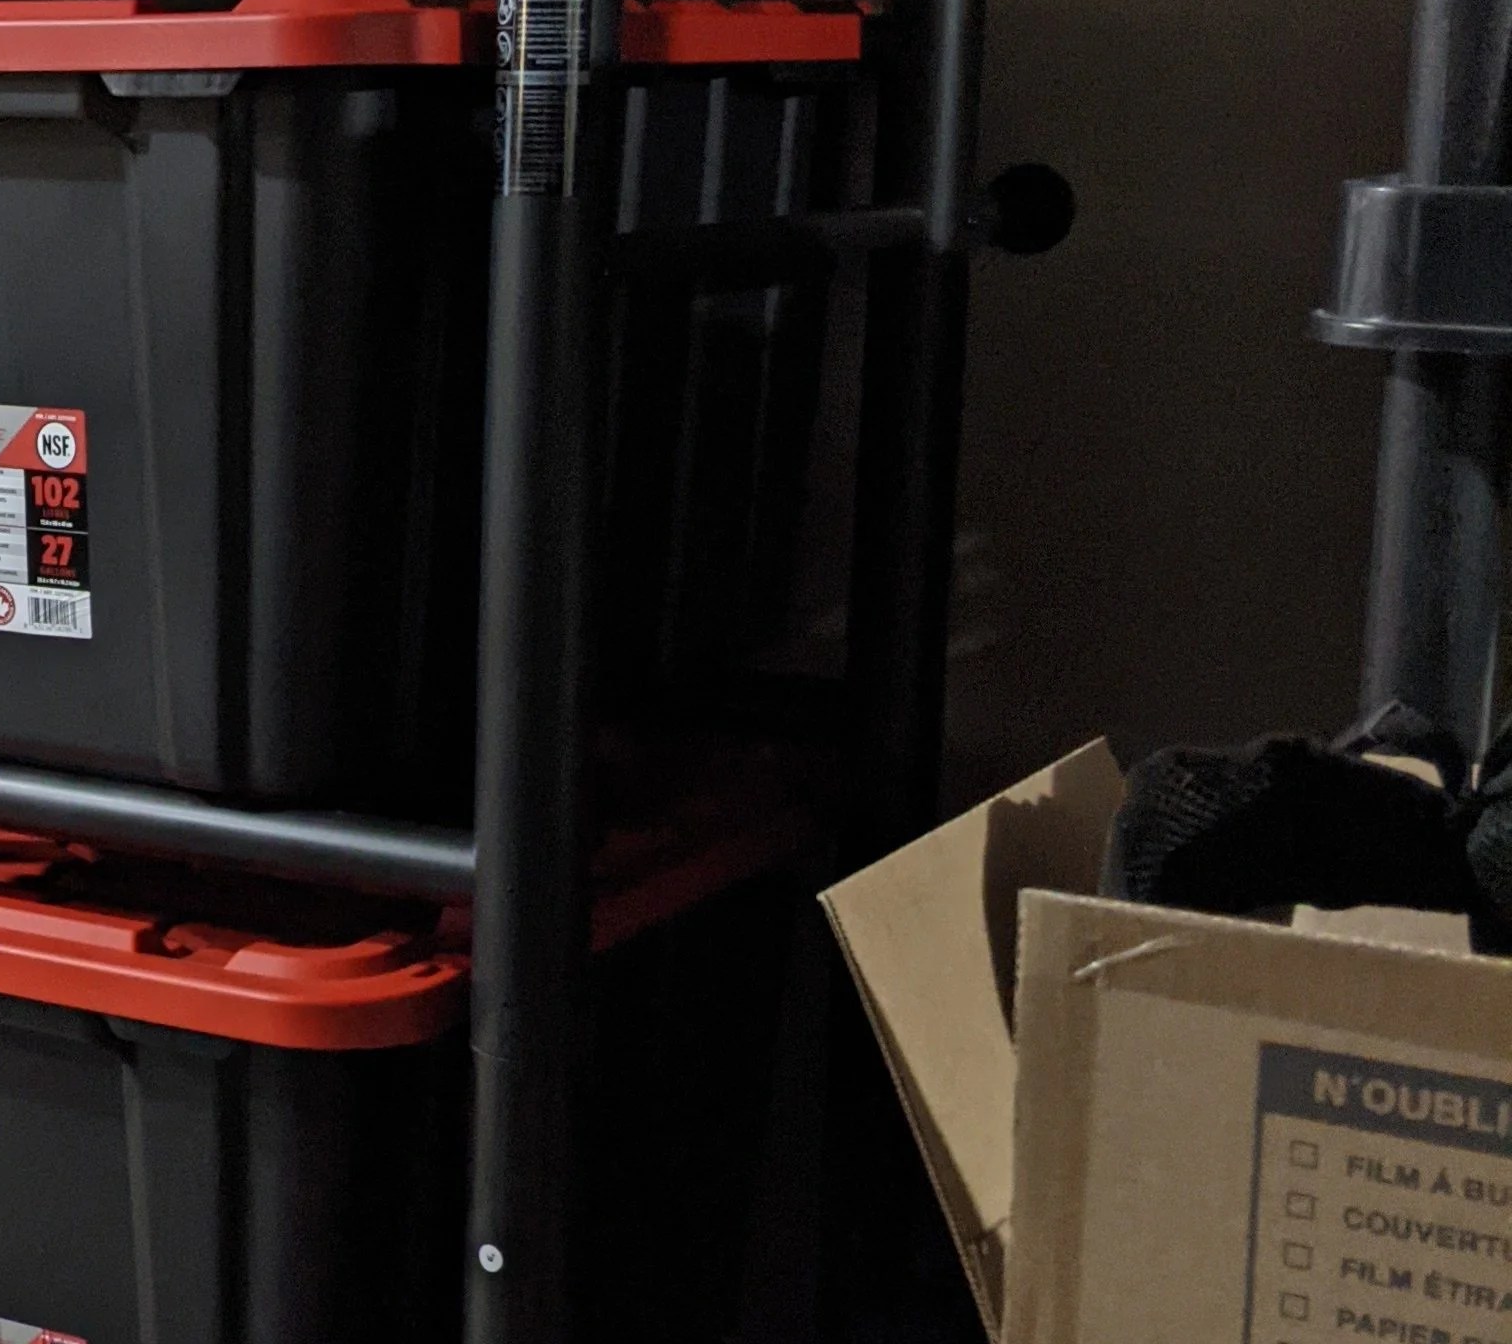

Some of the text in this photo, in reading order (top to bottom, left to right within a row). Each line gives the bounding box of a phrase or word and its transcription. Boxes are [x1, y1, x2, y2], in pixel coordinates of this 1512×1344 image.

[42, 434, 70, 456] NSF
[31, 476, 80, 509] 102
[40, 534, 74, 567] 27
[1346, 1155, 1421, 1190] FILM
[1341, 1257, 1412, 1291] FILM
